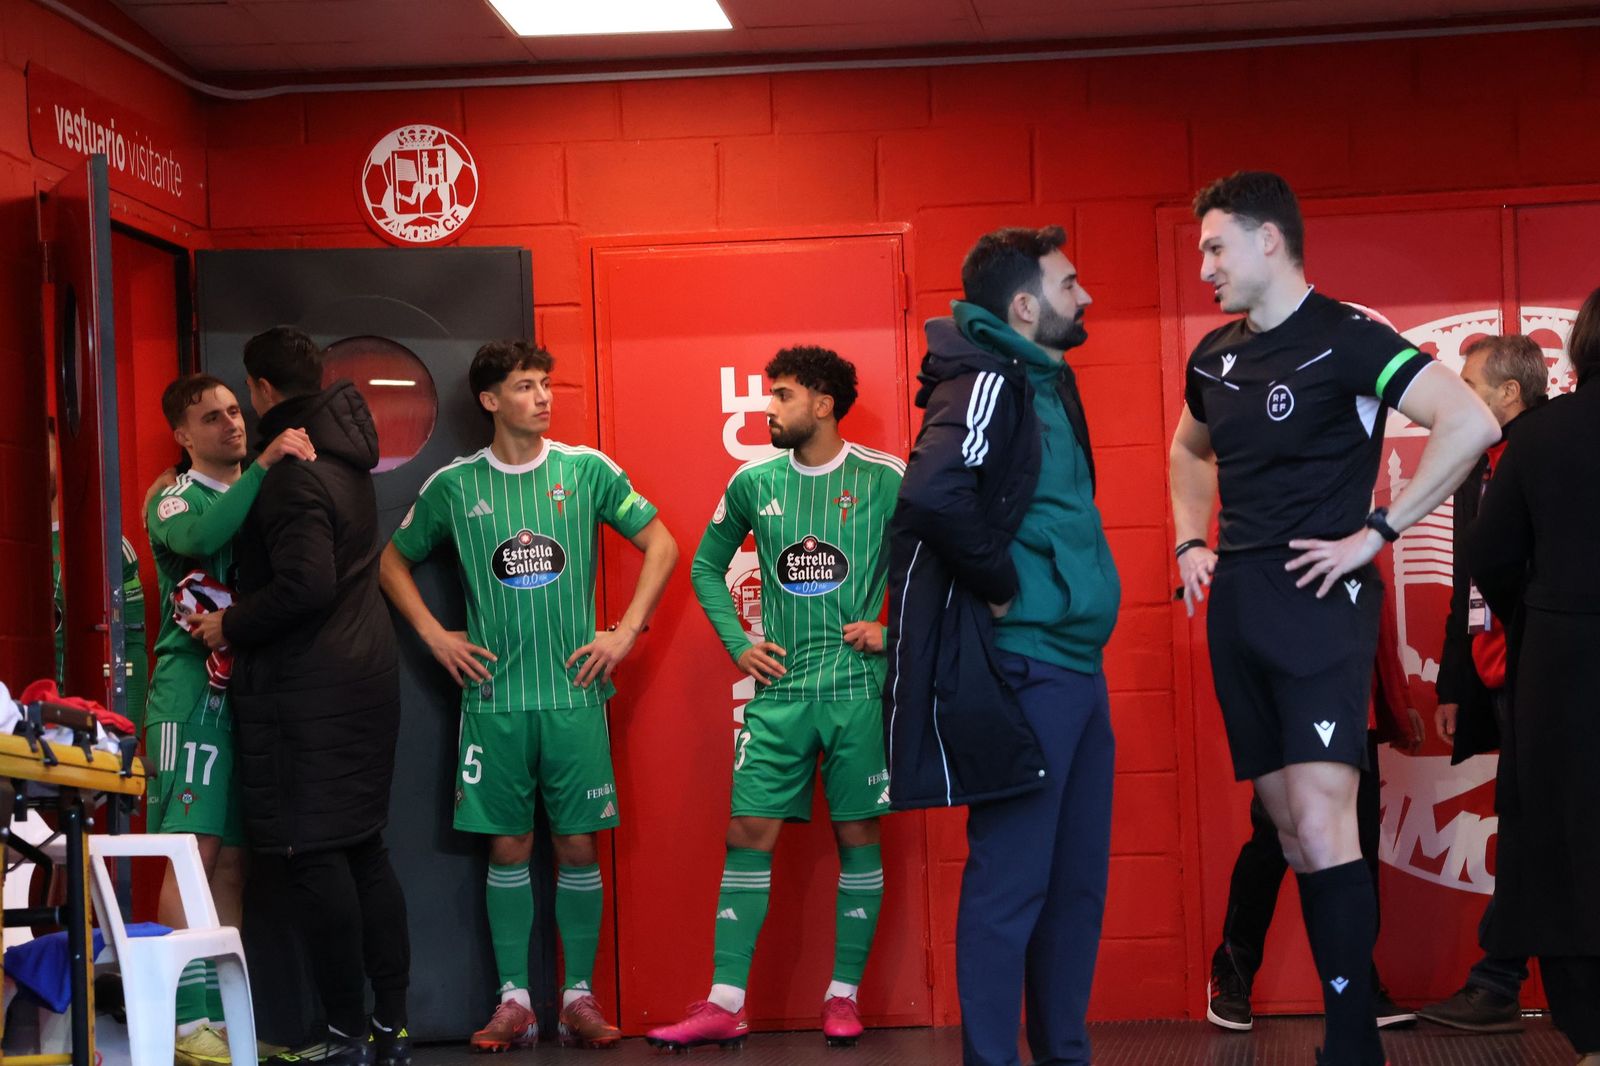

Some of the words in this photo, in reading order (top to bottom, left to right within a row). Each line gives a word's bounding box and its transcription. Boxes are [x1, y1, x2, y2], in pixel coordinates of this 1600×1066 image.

[54, 103, 126, 172] vestuario
[127, 131, 183, 198] visitante
[381, 219, 442, 241] ZAMORA
[502, 544, 553, 562] Estrella
[786, 552, 836, 567] Estrella
[505, 558, 552, 576] Galicia
[788, 566, 833, 581] Galicia
[183, 741, 219, 786] 17
[462, 743, 484, 784] 5
